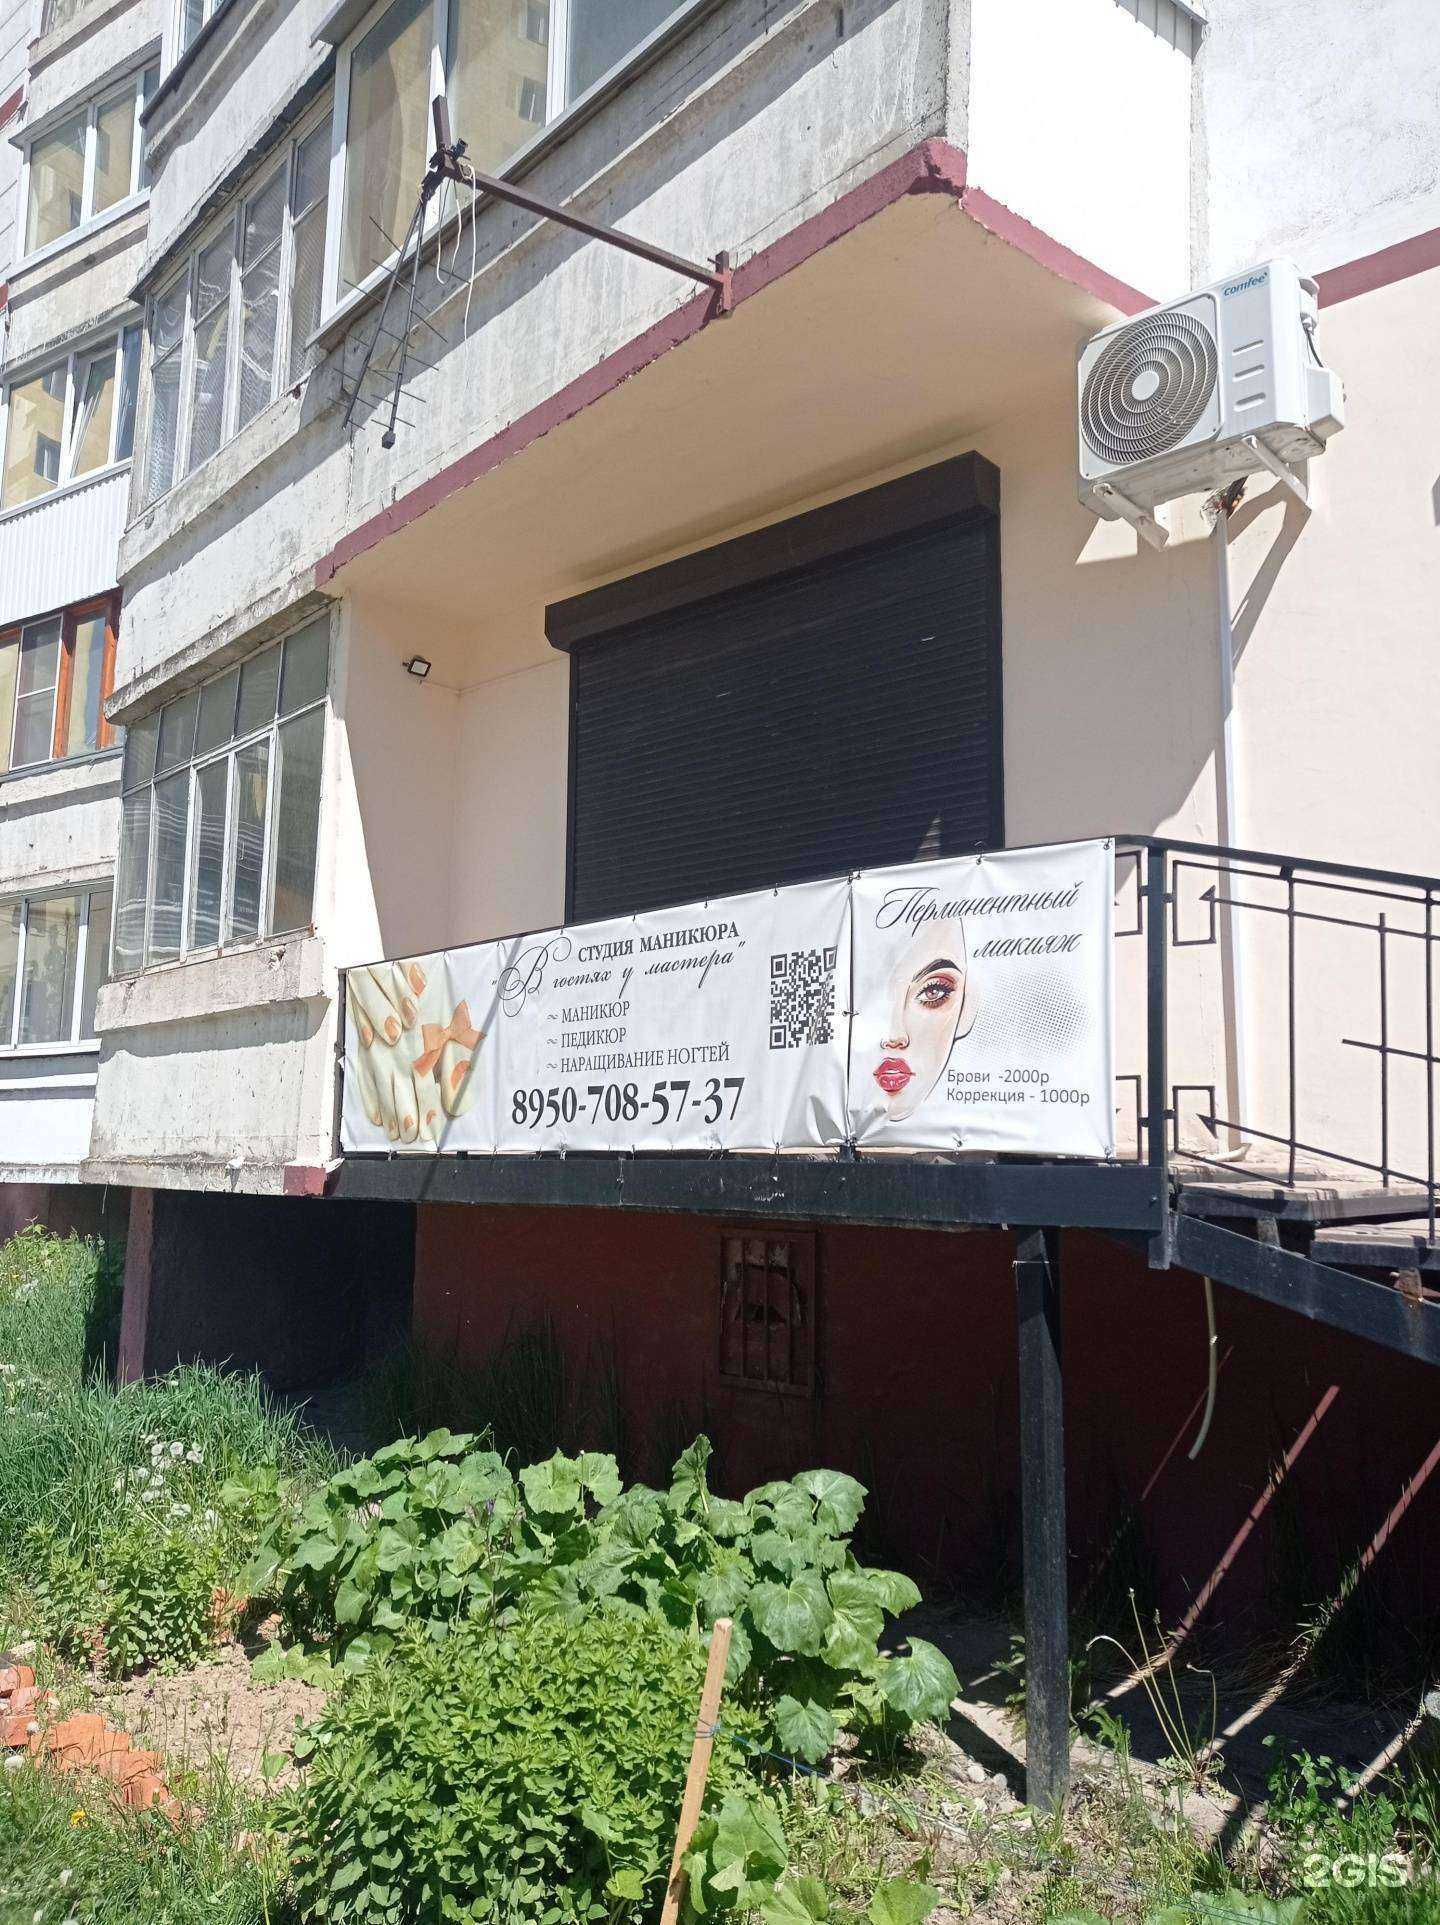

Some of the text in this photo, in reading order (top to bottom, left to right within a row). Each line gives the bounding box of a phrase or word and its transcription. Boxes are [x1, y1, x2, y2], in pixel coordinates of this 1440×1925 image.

[875, 880, 1084, 937] Перманентный
[578, 921, 740, 962] СТУДИЯ МАНИКЮРА
[972, 933, 1083, 959] макияж
[561, 1000, 630, 1024] МАНИКЮР
[560, 1027, 627, 1049] ПЕДИКЮР
[560, 1041, 730, 1073] НАРАЩИВАНИЕ НОГТЕЙ
[947, 1069, 990, 1085] Брови
[511, 1077, 746, 1129] 8950-708-57-37
[946, 1088, 1025, 1104] Коррекция
[1041, 1089, 1090, 1107] 1000р
